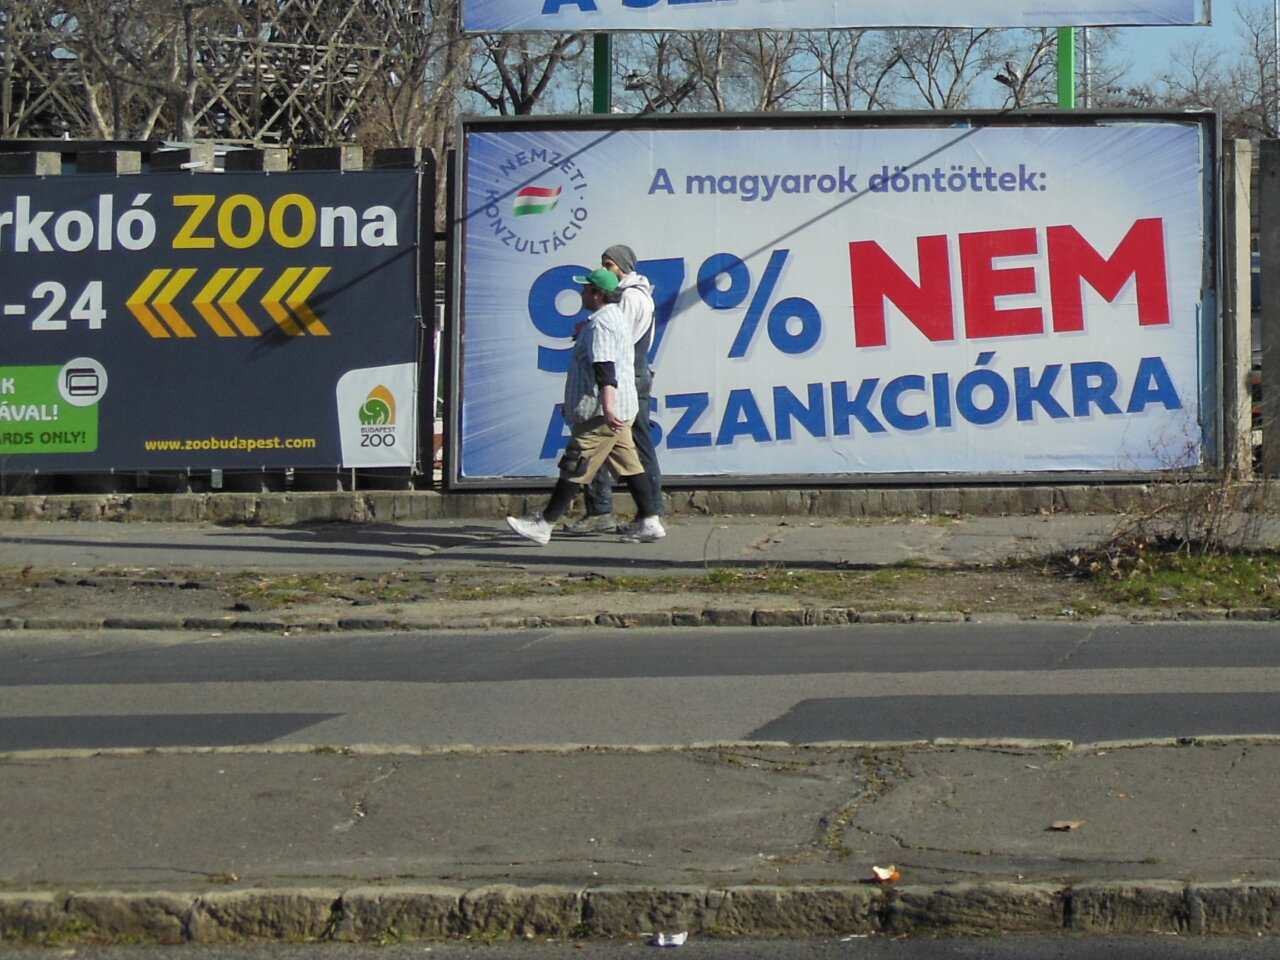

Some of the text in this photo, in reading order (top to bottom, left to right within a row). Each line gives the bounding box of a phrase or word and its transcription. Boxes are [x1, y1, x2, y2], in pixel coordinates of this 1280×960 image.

[499, 148, 588, 191] NEMZETI
[647, 163, 1047, 201] A magyarok döntöttek:
[172, 193, 398, 249] ZOOna
[486, 189, 588, 255] KONZULTÁCIÓ
[849, 217, 1170, 347] NEM
[0, 431, 86, 445] RDS ONLY!
[145, 436, 317, 452] www.zoobudapest.com
[361, 426, 396, 434] BUDAPEST
[361, 434, 396, 448] ZOO
